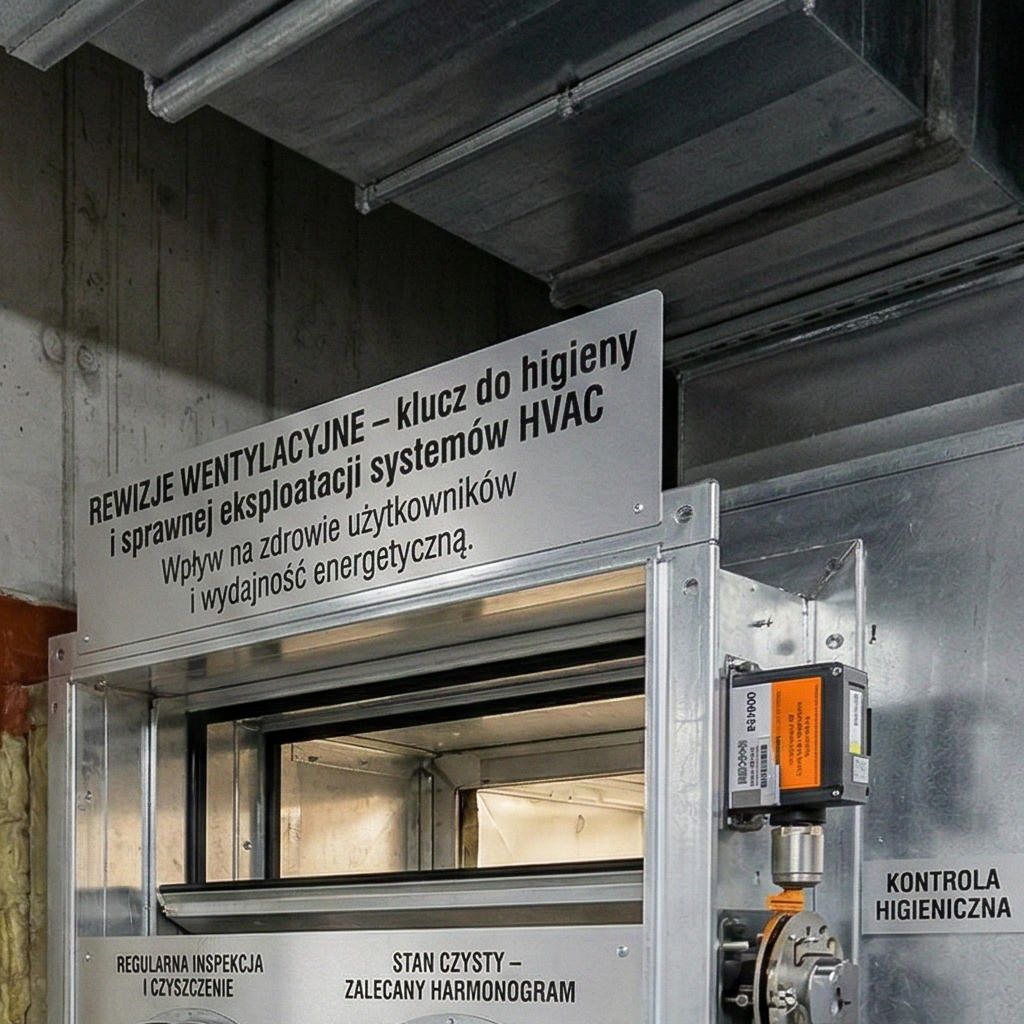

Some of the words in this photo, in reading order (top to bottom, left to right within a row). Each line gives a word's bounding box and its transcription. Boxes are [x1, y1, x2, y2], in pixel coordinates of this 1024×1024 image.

[89, 471, 174, 525] REWIZJE
[180, 409, 365, 497] WENTYLACYJNE
[397, 384, 467, 430] klucz
[477, 367, 511, 406] do
[522, 329, 638, 392] higieny
[110, 528, 116, 557] i
[121, 498, 214, 558] sprawnej
[220, 454, 361, 524] eksploatacji
[370, 417, 509, 488] systemów
[520, 383, 604, 442] HVAC
[161, 548, 224, 586] Wpływ
[230, 539, 254, 567] na
[260, 515, 340, 560] zdrowie
[348, 469, 518, 538] użytkowników
[190, 588, 195, 613] i
[201, 558, 307, 614] wydajność
[314, 527, 474, 586] energetyczną.
[887, 868, 1001, 893] KONTROLA
[876, 897, 1012, 921] HIGIENICZNA
[117, 955, 189, 973] REGULARNA
[193, 954, 264, 973] INSPEKCJA
[392, 951, 434, 973] STAN
[440, 951, 505, 973] CZYSTY
[143, 978, 147, 997] I
[151, 977, 234, 997] CZYSZCZENIE
[345, 979, 426, 1000] ZALECANY
[431, 980, 576, 1003] HARMONOGRAM
